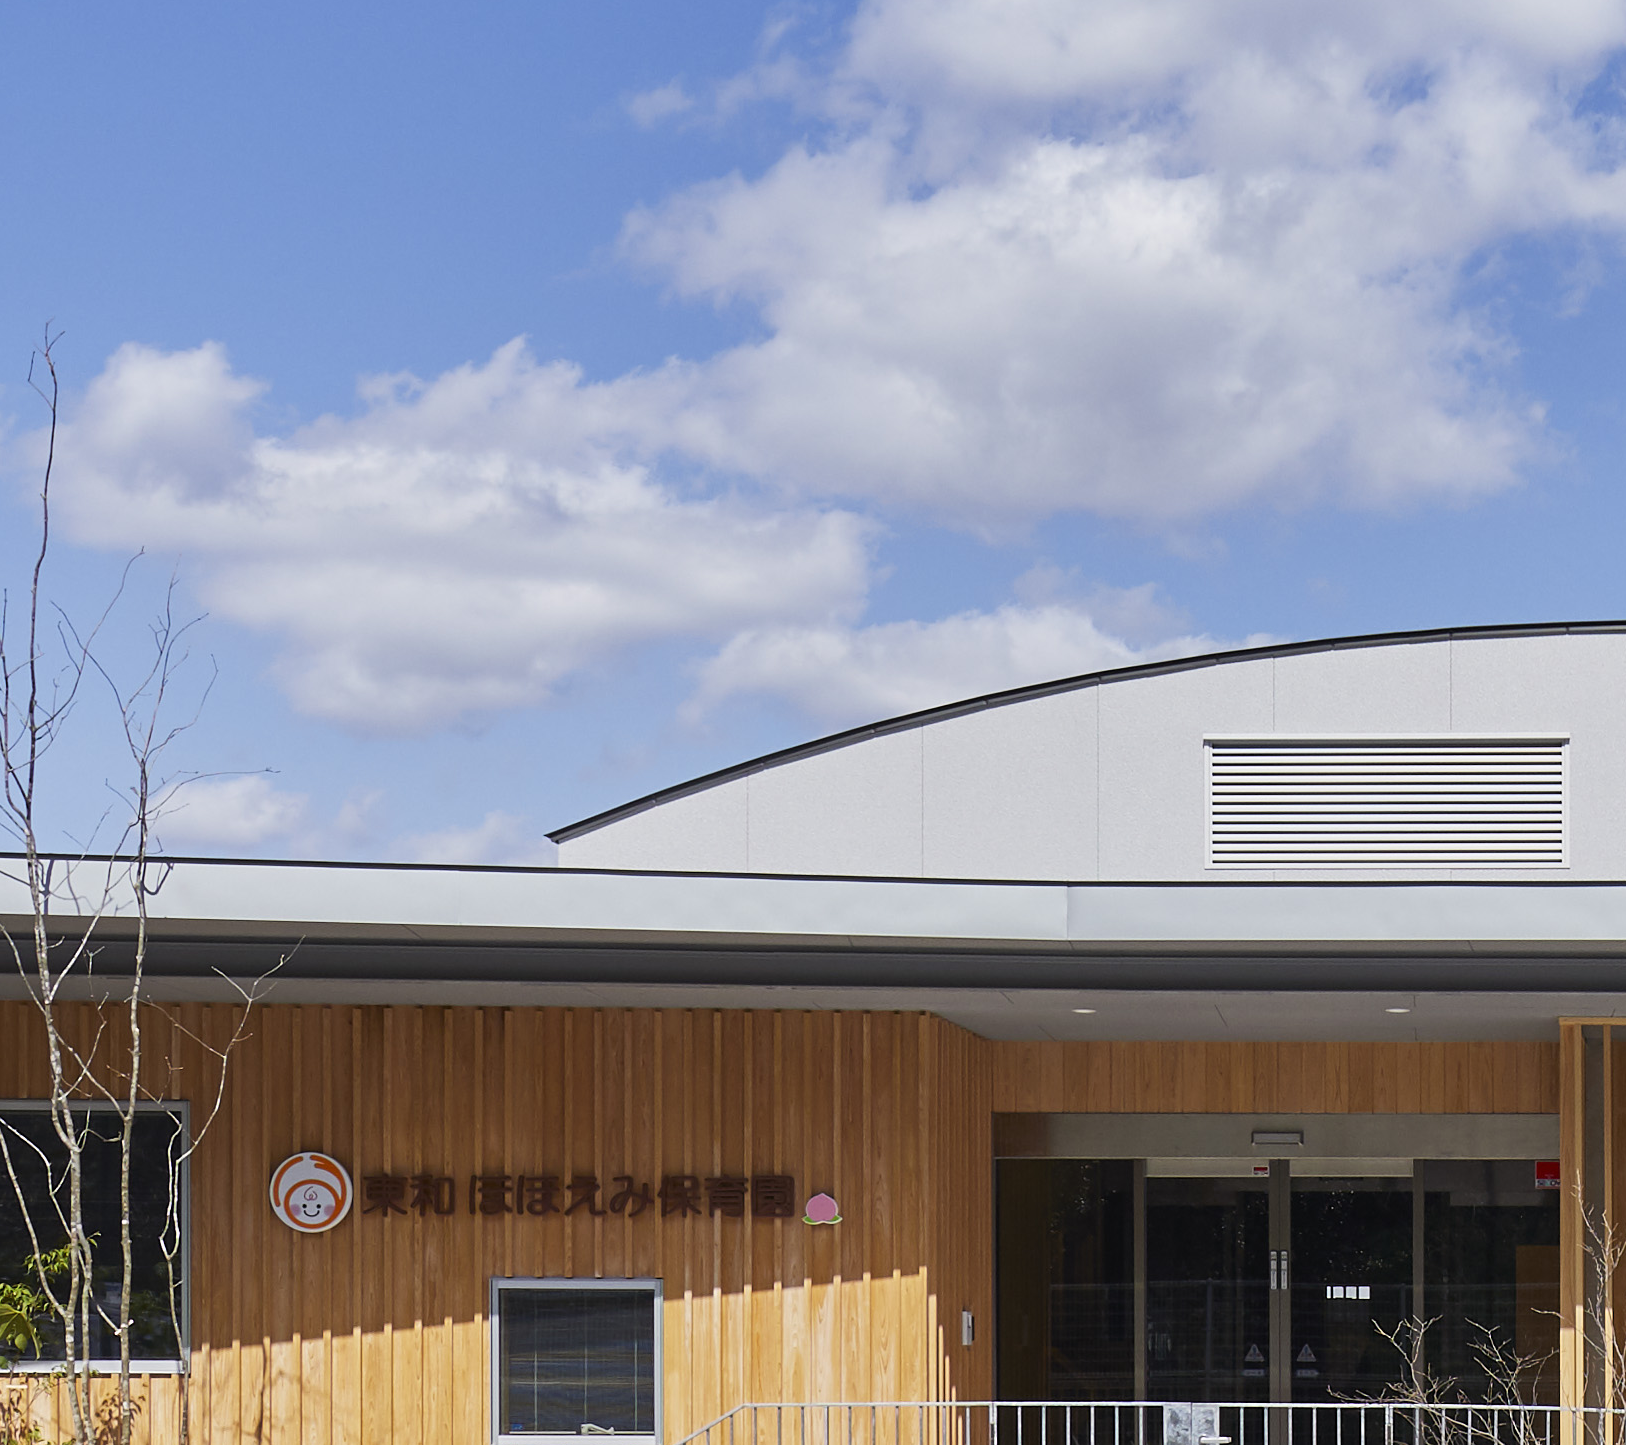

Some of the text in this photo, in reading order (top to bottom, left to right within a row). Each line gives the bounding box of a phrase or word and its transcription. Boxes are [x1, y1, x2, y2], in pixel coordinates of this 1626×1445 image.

[362, 1173, 795, 1218] 東和 ほほえみ保育園
